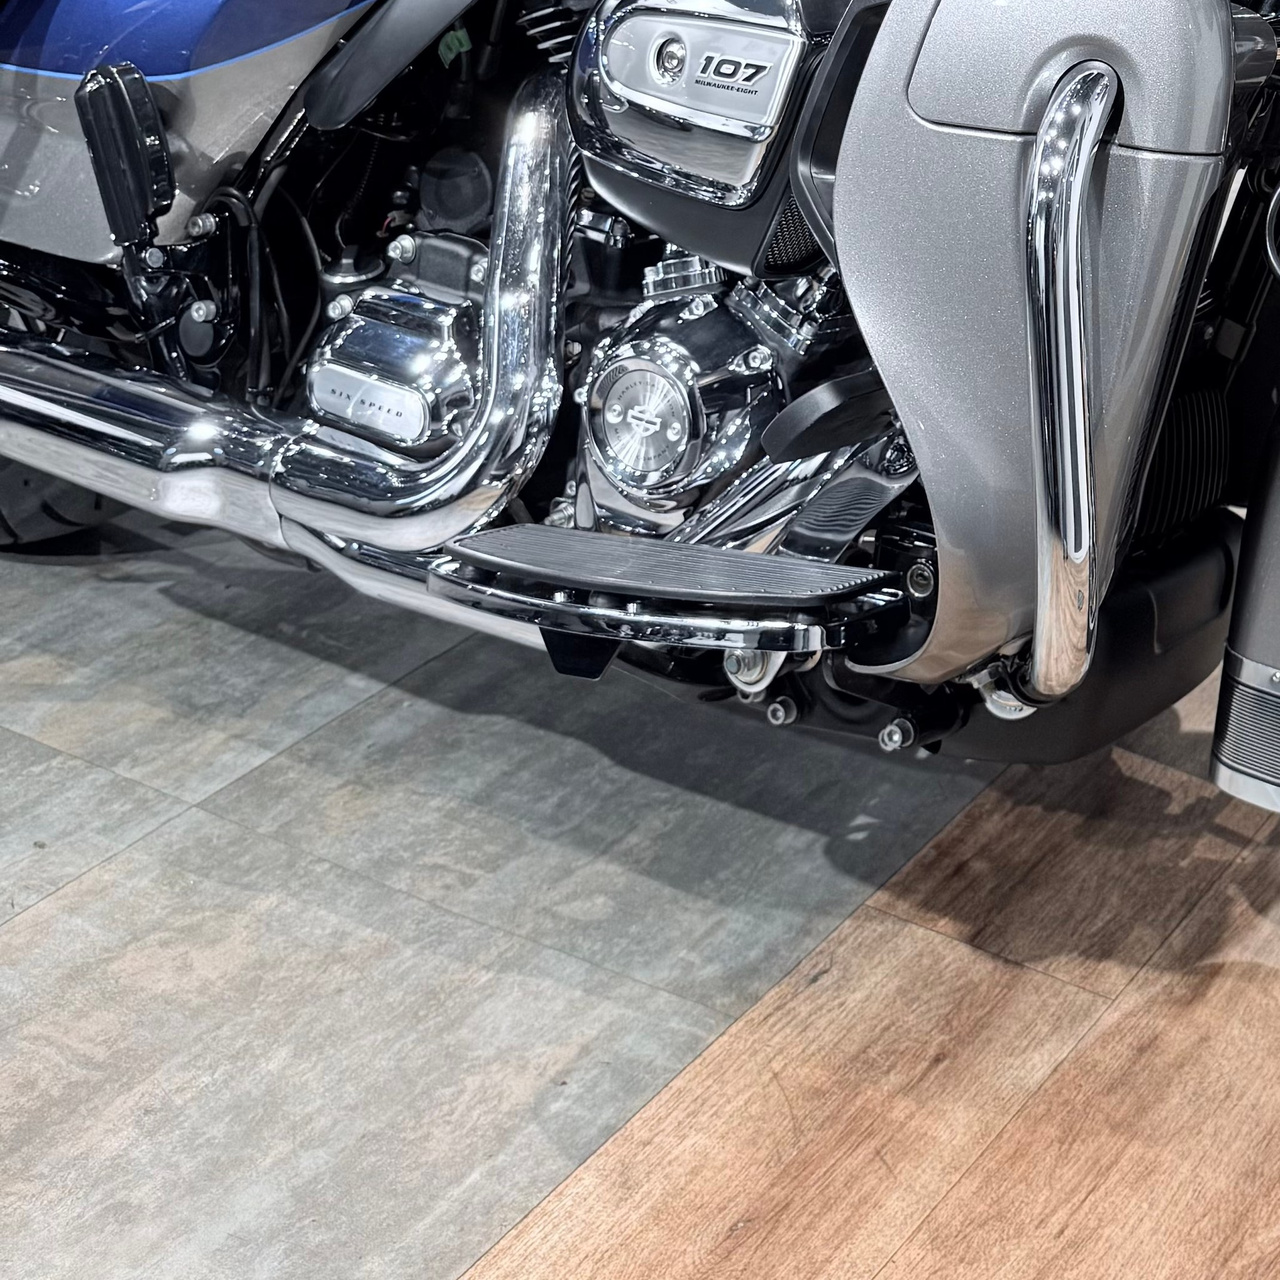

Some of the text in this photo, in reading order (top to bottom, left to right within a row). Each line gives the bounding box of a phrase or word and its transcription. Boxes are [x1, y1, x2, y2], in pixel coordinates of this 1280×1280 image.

[698, 53, 771, 85] 107
[694, 79, 759, 96] MILWAUKEE-EIGHT
[330, 388, 403, 417] SIX SPEED
